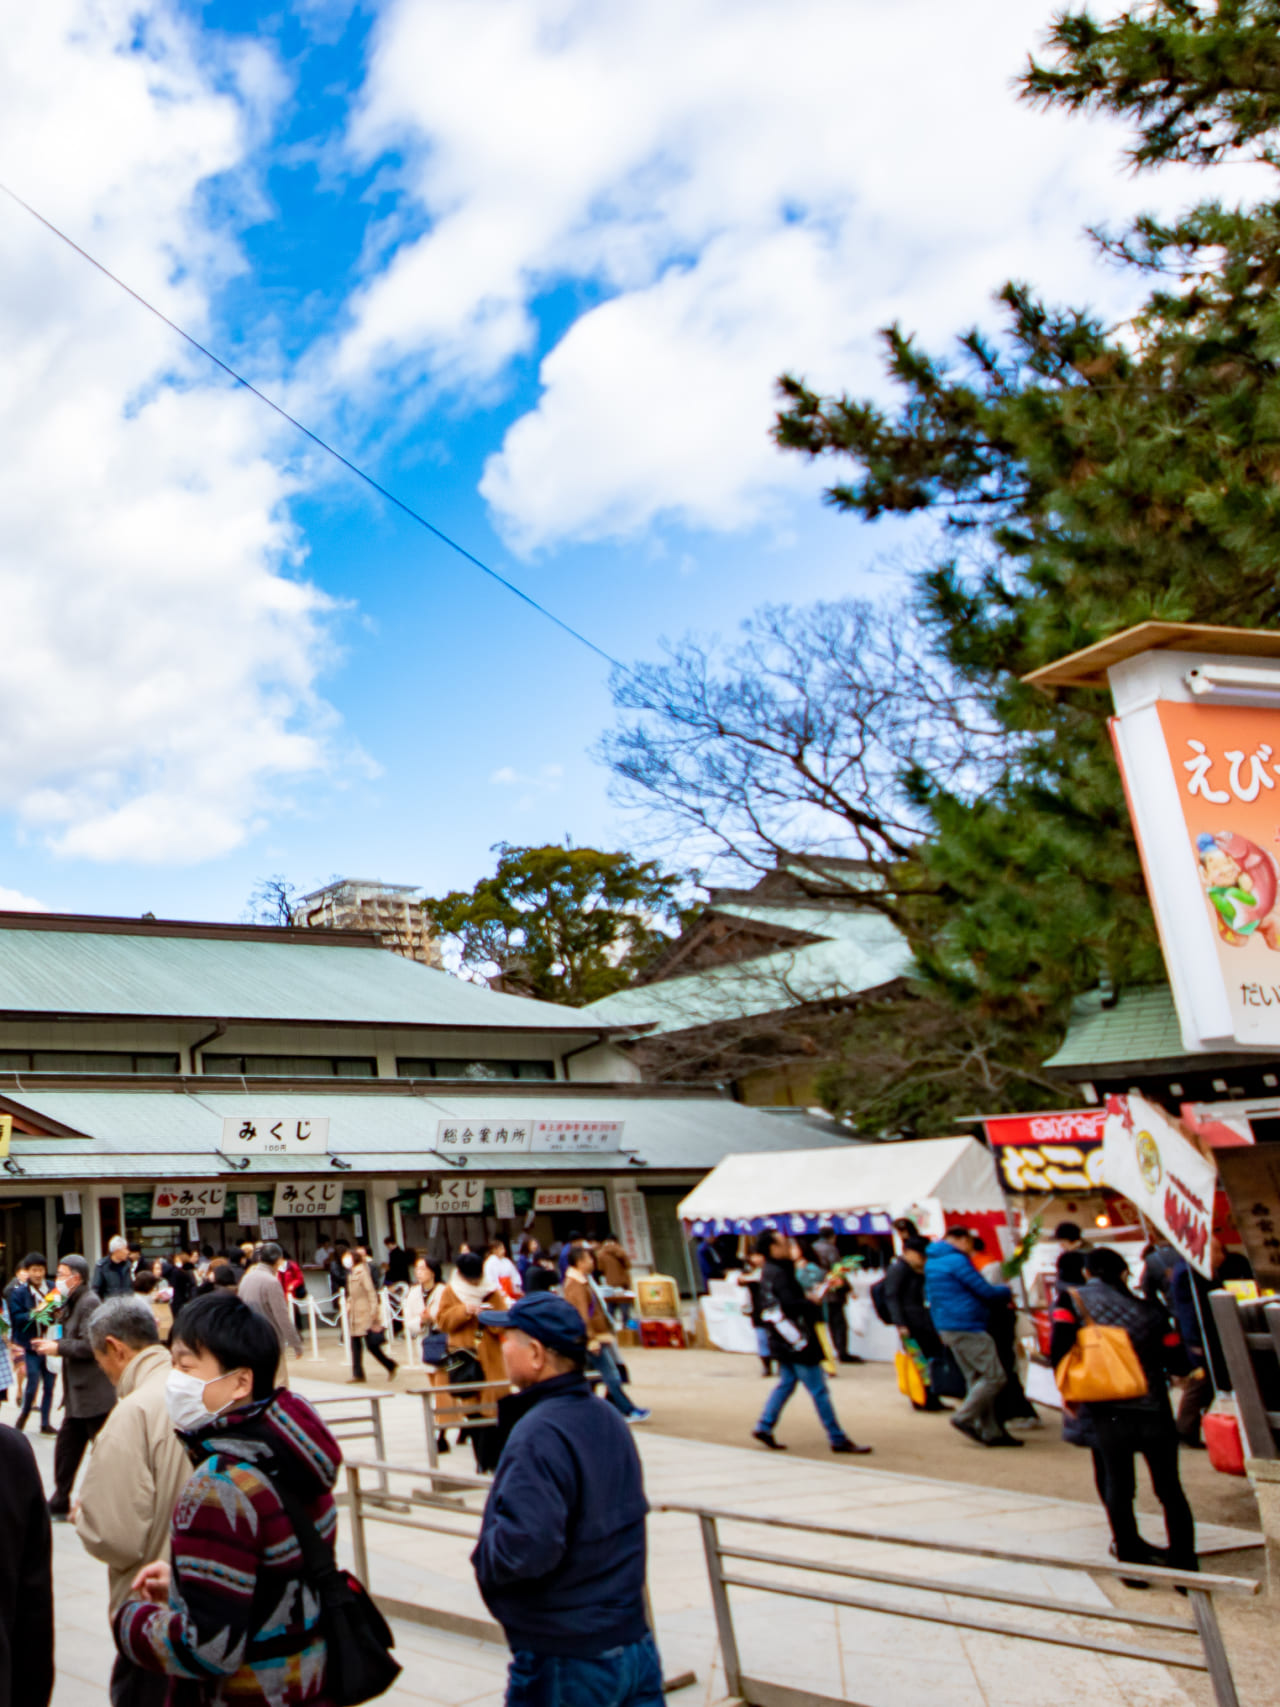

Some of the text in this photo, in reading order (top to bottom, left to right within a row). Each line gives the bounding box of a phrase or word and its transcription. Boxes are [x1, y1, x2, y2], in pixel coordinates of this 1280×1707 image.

[1183, 739, 1280, 803] えび
[238, 1120, 312, 1141] みくじ
[442, 1127, 526, 1145] 総合案内所
[264, 1144, 287, 1152] 100円
[179, 1188, 223, 1205] みくじ
[282, 1184, 336, 1202] みくじ
[429, 1181, 478, 1198] くじ
[170, 1207, 206, 1217] 300円
[288, 1203, 327, 1214] 100円
[434, 1200, 471, 1211] 100円
